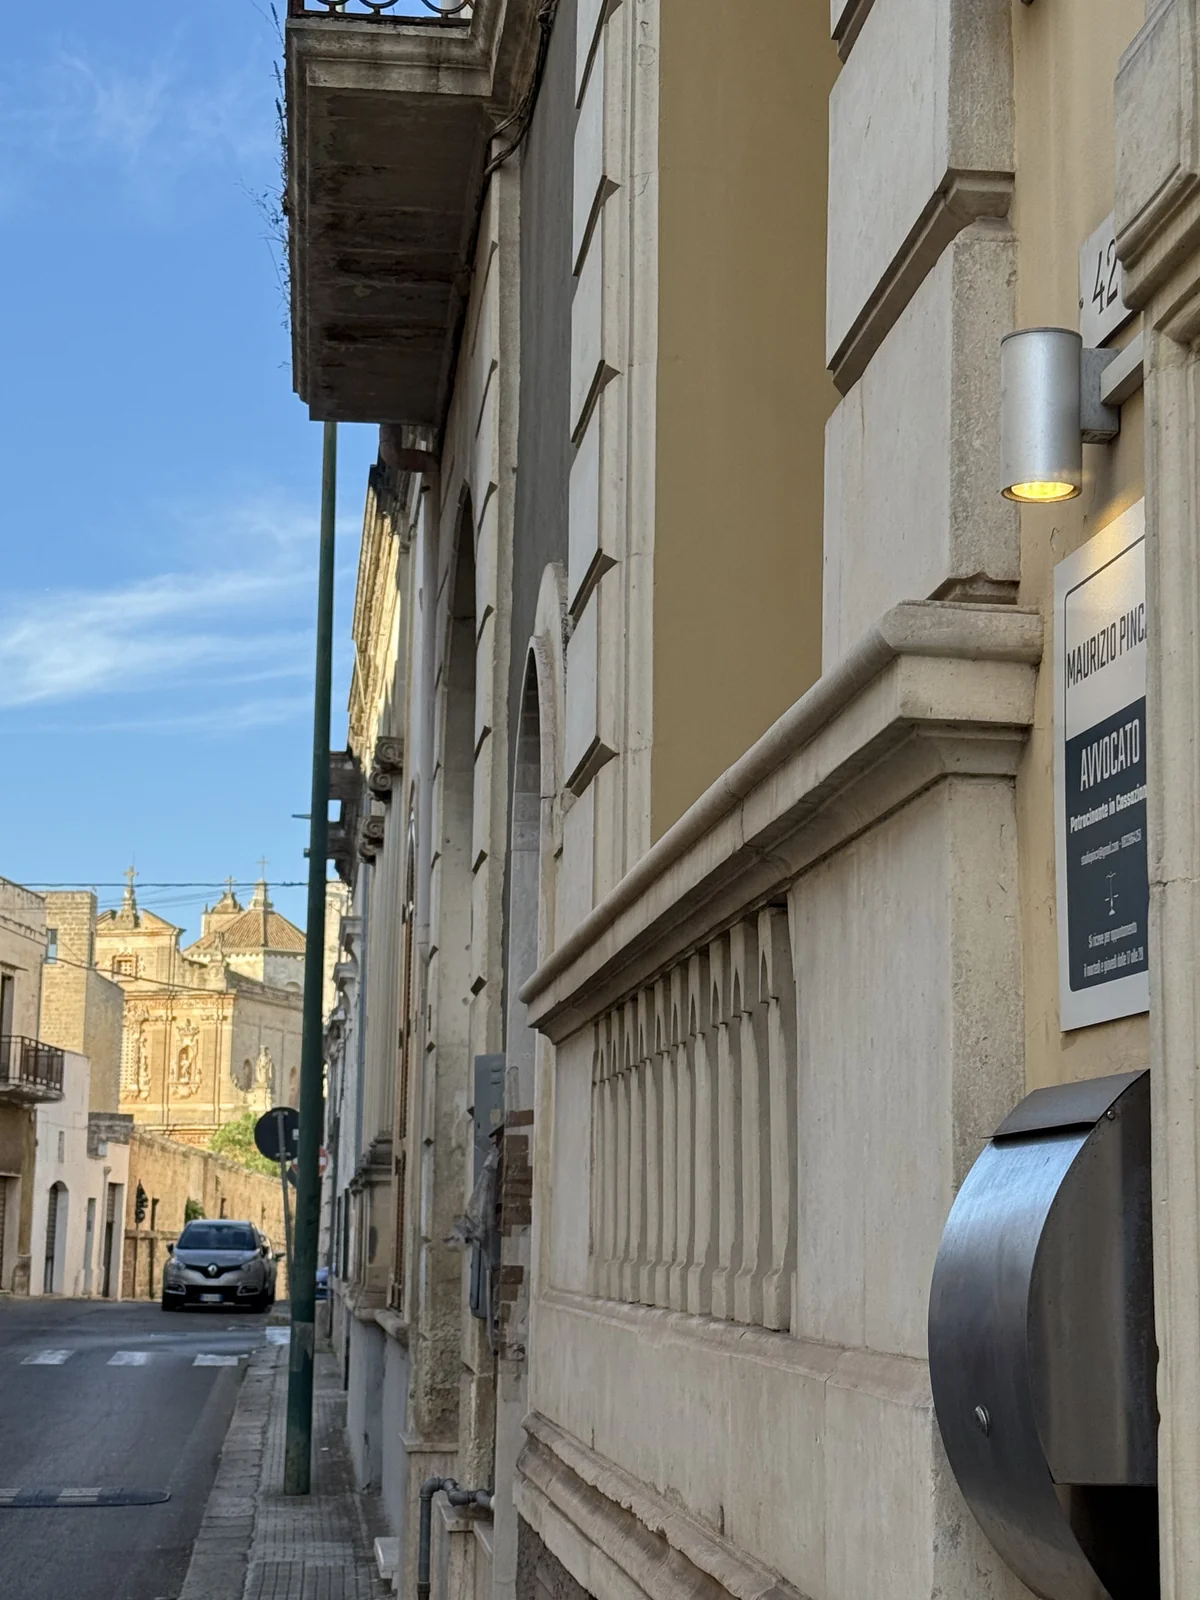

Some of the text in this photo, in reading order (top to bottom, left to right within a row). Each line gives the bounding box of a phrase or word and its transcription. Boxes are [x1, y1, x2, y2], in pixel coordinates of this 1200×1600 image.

[1092, 238, 1118, 315] 42
[1067, 622, 1116, 689] MAURIZIO
[1080, 718, 1139, 791] AVVOCATO
[1109, 797, 1116, 816] in
[1116, 783, 1147, 812] Cassazion
